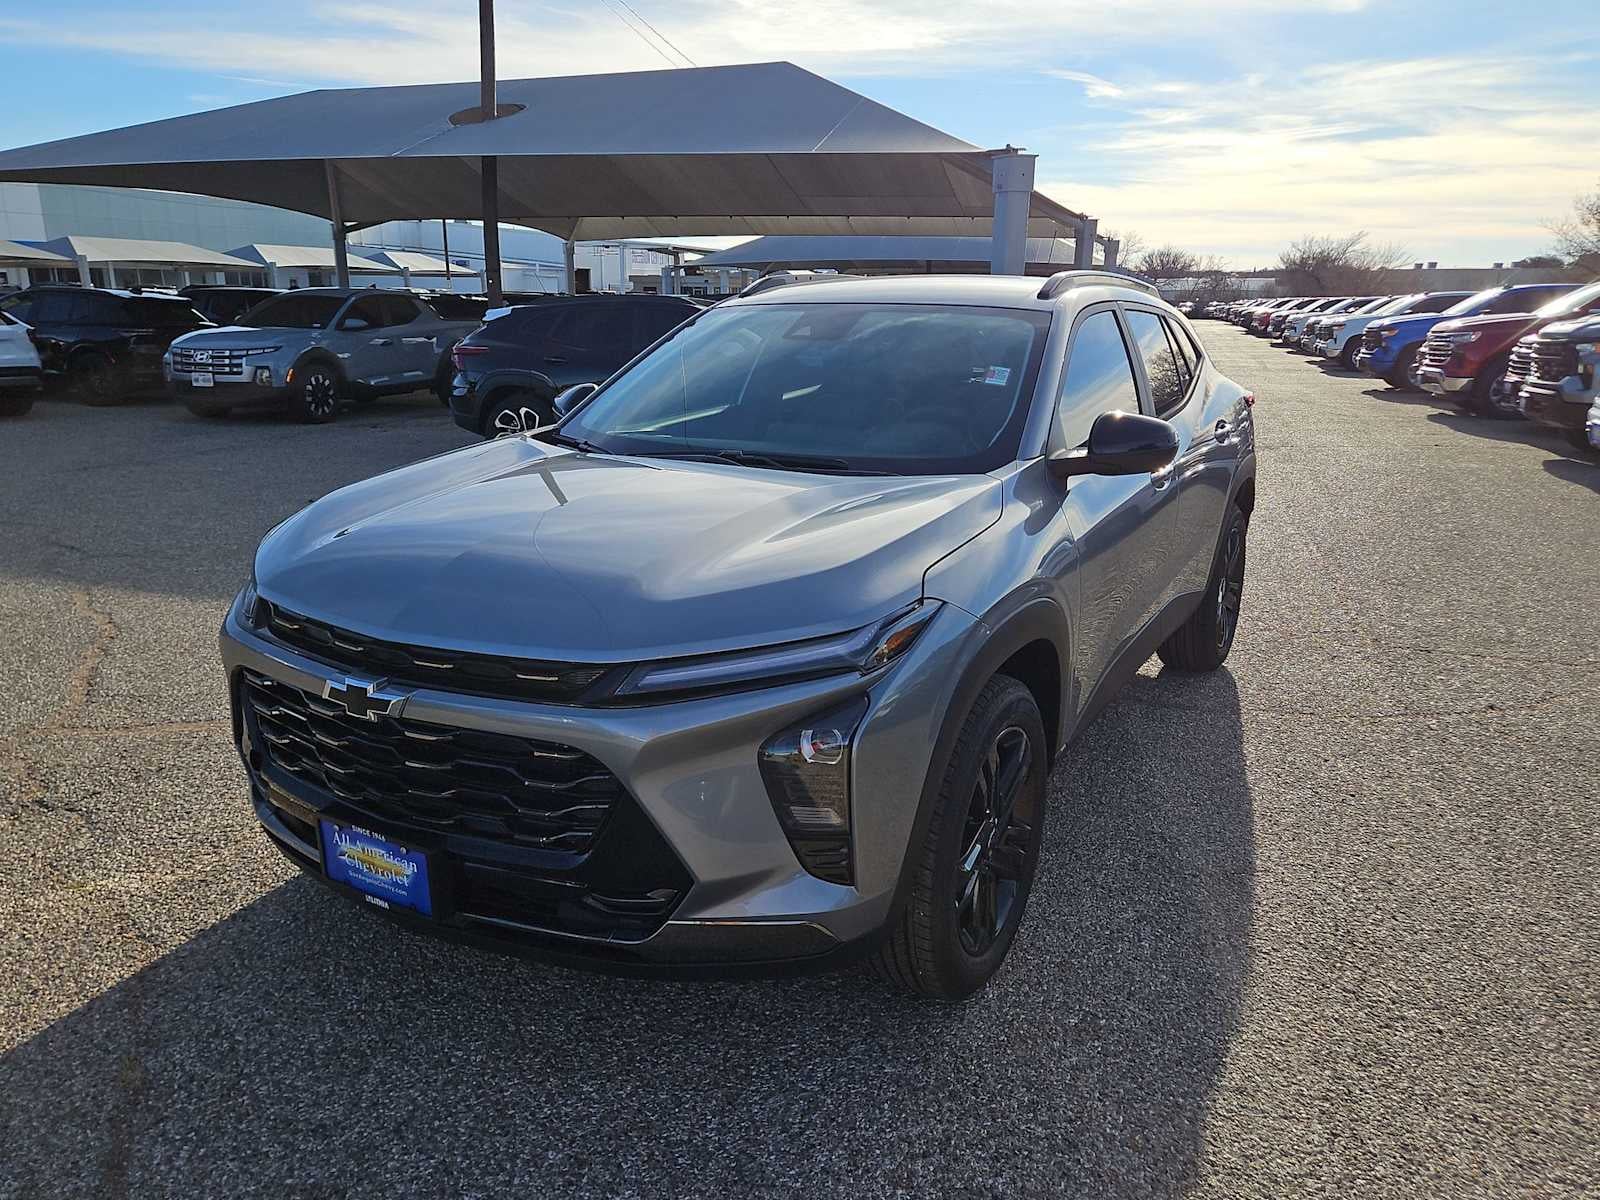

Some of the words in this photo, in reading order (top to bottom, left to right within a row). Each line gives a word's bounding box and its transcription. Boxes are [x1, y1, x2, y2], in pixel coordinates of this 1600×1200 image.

[351, 825, 370, 837] SINCE
[333, 832, 350, 848] All
[355, 841, 418, 873] American
[345, 853, 409, 887] Chevrolet
